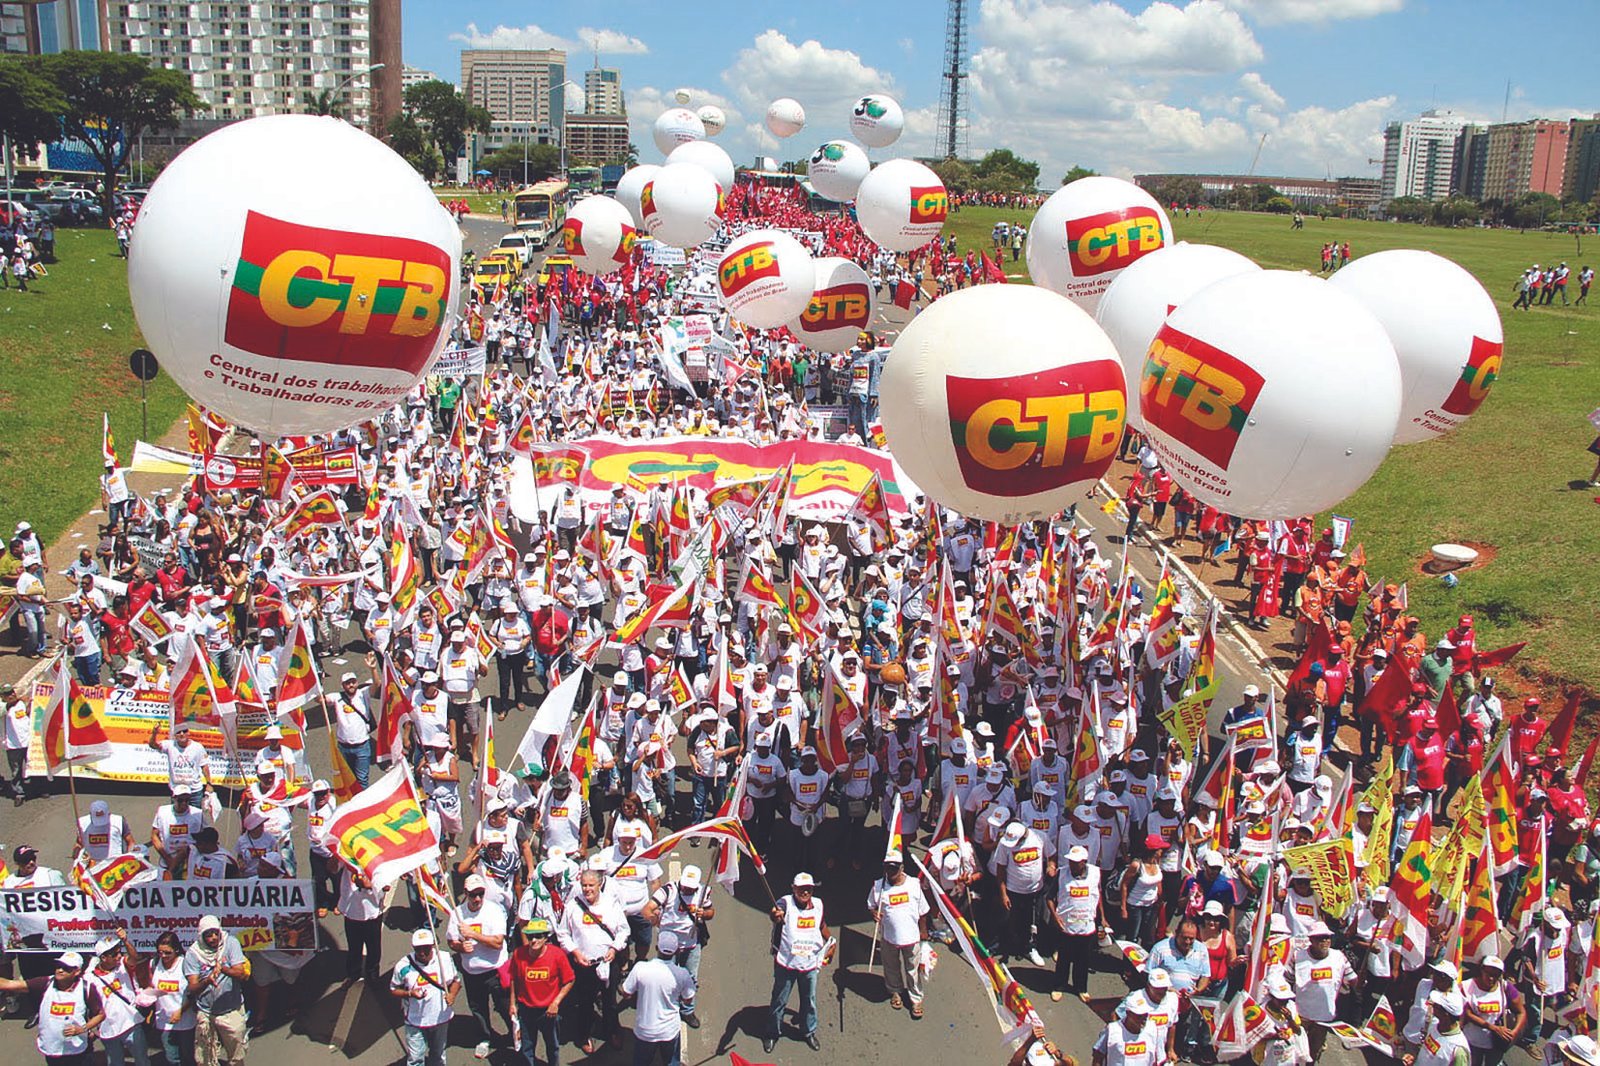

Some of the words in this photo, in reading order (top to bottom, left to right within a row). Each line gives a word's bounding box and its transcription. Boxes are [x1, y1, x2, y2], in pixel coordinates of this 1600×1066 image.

[917, 193, 947, 216] CT
[1077, 216, 1161, 267] CTB
[721, 246, 775, 289] CTB
[1067, 281, 1096, 290] Central
[258, 249, 447, 337] CTB
[803, 294, 867, 322] CTB
[209, 354, 279, 383] Central
[283, 375, 318, 389] dos
[204, 370, 214, 379] e
[221, 374, 352, 407] Trabalhadoras
[355, 399, 373, 410] do
[1140, 339, 1246, 431] CTB
[965, 389, 1126, 471] CTB
[329, 458, 352, 468] CTB
[1151, 436, 1228, 486] trabalhadores
[591, 451, 875, 496] CTB
[1193, 476, 1232, 498] Brasil
[144, 610, 167, 635] CTB
[1520, 728, 1536, 736] CUT
[855, 769, 869, 777] CTB
[801, 784, 817, 792] CTB
[1133, 785, 1147, 793] CTB
[551, 809, 569, 817] CTB
[171, 826, 188, 834] CTB
[90, 835, 107, 843] CTB
[1013, 850, 1038, 861] CTB
[101, 860, 141, 890] CTB
[4, 887, 166, 913] RESISTCIA
[171, 881, 306, 908] PORTUÁRIA
[1071, 887, 1089, 896] CTB
[889, 894, 910, 903] CTB
[131, 915, 142, 928] &
[797, 918, 816, 928] CTB
[526, 970, 549, 978] CTB
[1312, 969, 1333, 979] CTB
[157, 981, 179, 992] CTB
[50, 1004, 75, 1015] CTB
[1479, 1003, 1501, 1013] CTB
[1125, 1044, 1146, 1054] CTB
